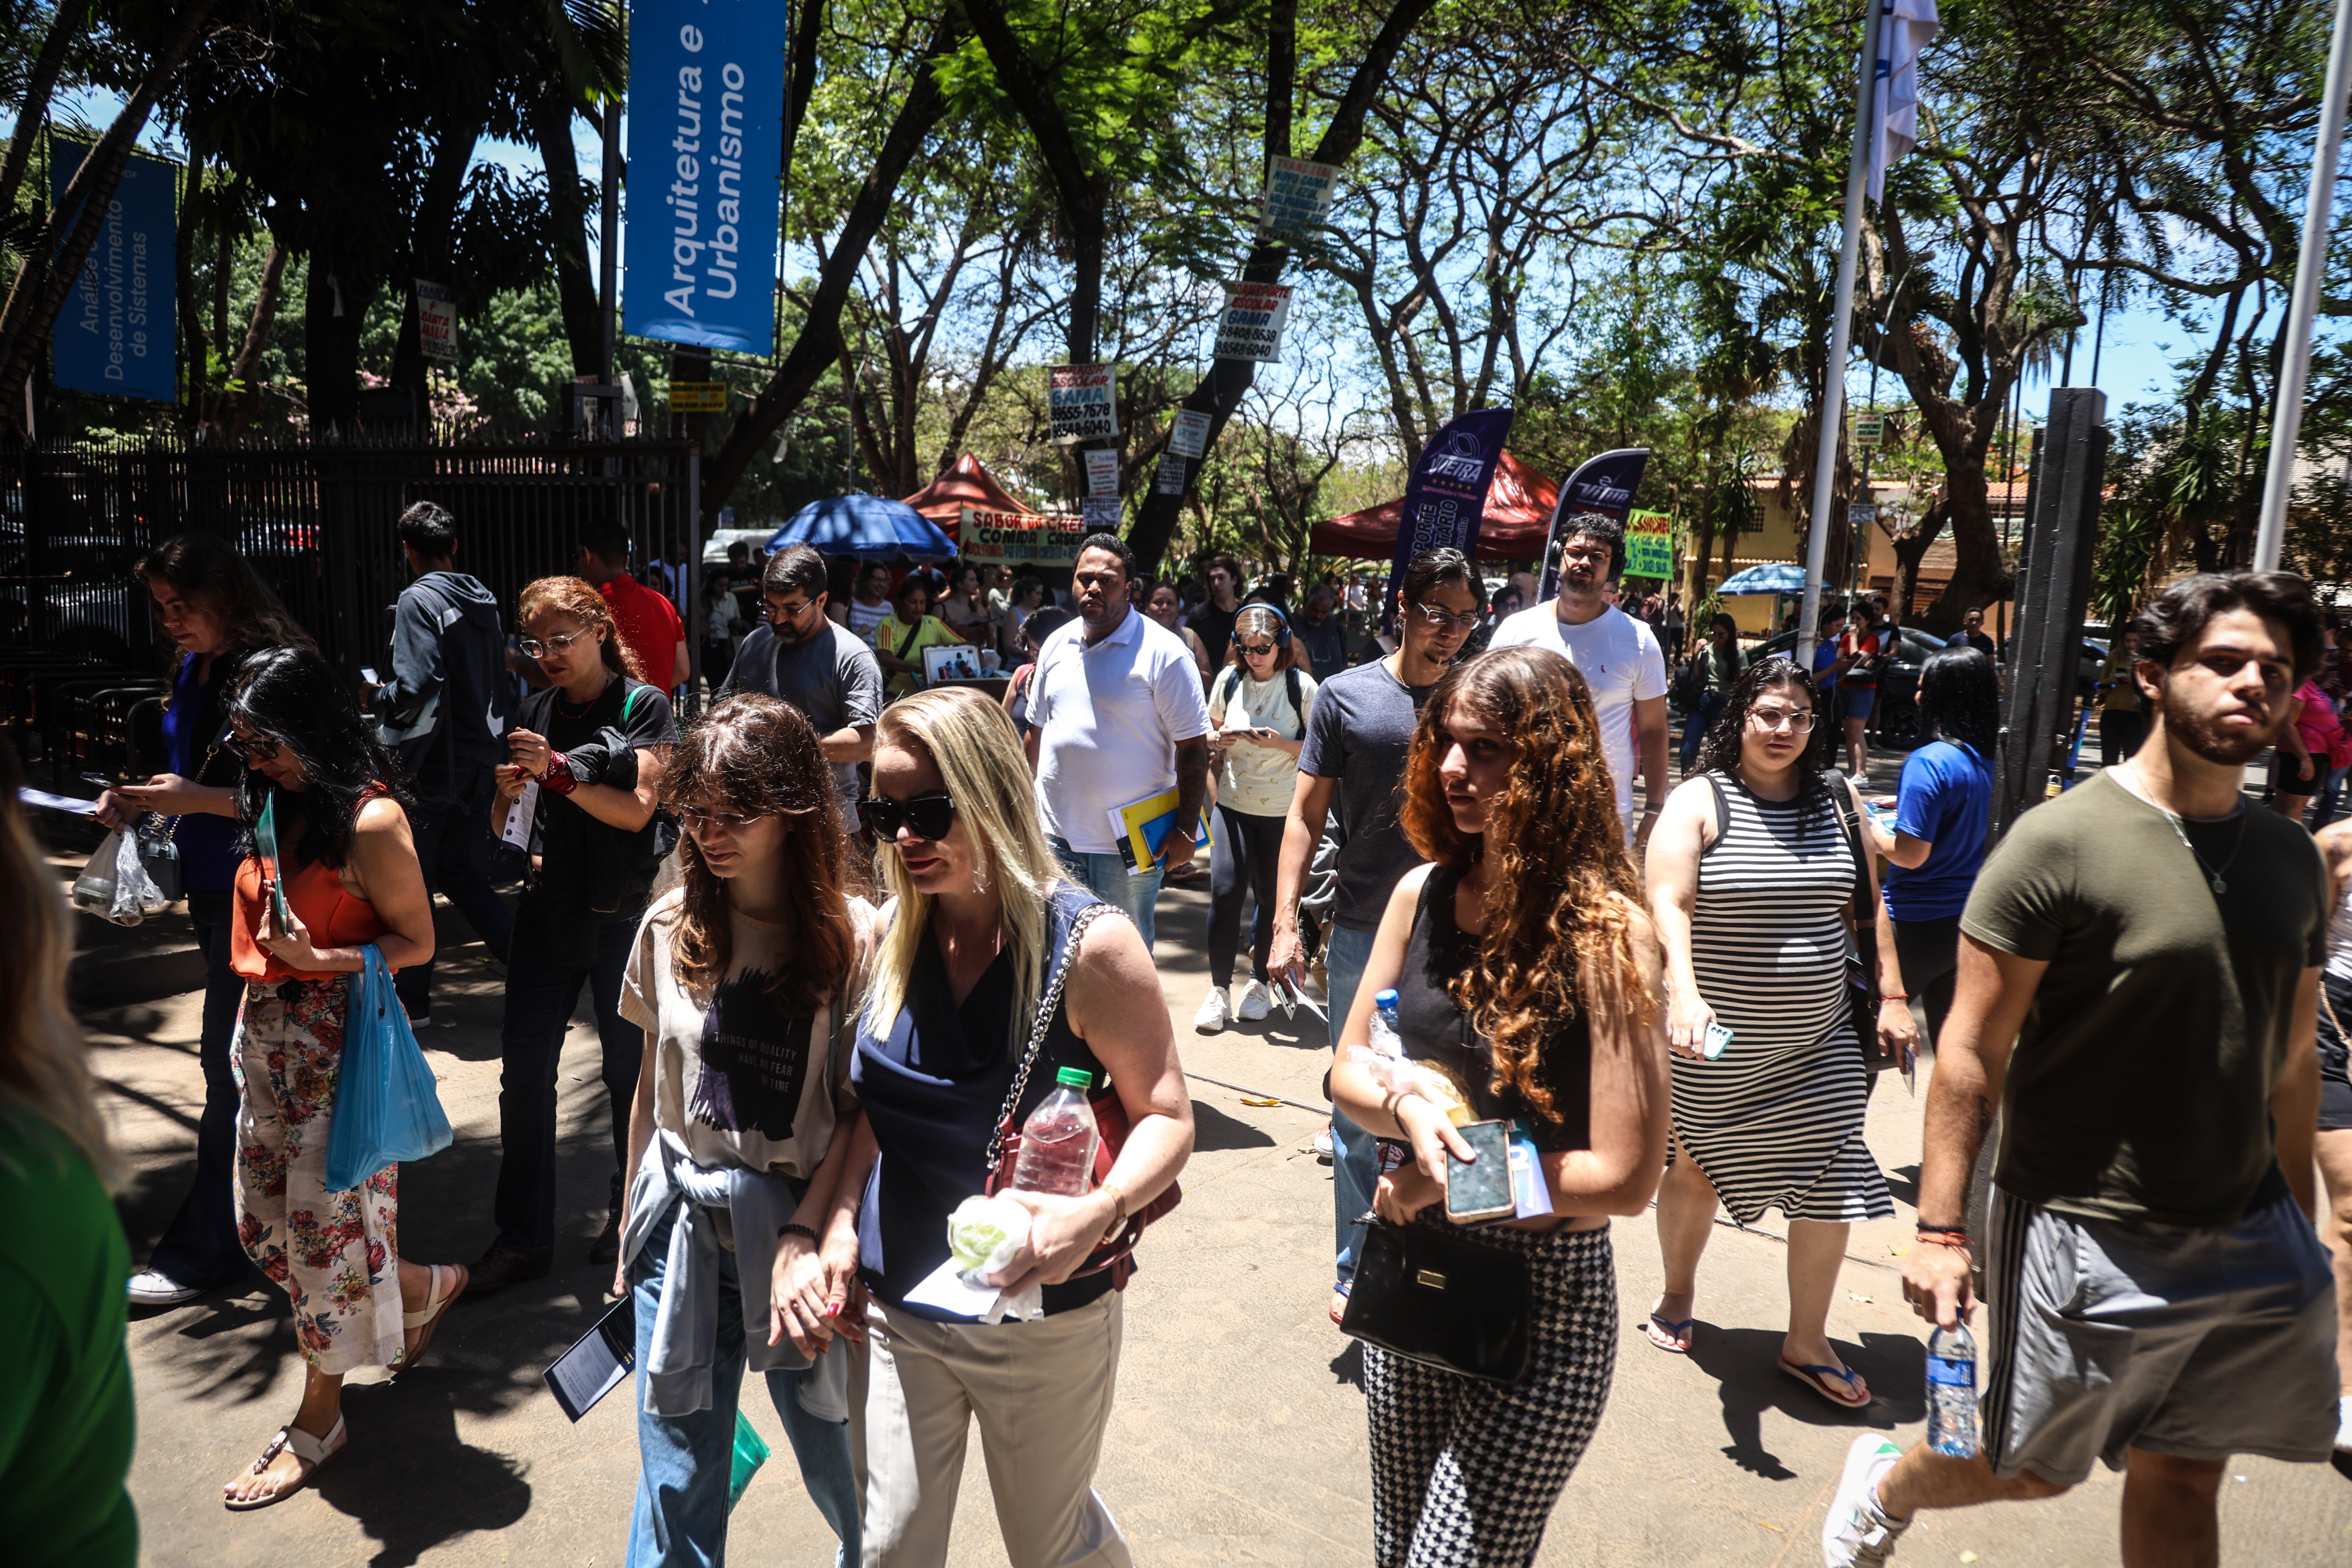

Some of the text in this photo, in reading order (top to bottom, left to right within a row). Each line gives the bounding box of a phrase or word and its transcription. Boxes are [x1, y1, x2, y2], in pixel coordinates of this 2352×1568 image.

[665, 24, 704, 318] Arquitetura e
[707, 63, 745, 299] Urbanismo
[1274, 170, 1329, 190] NOVO GAMA
[1296, 186, 1318, 200] AZUL
[105, 200, 123, 381] Desenvolvimento
[128, 231, 147, 357] de Sistemas
[1232, 296, 1279, 312] ESCOLAR
[1227, 309, 1271, 326] GAMA
[1051, 375, 1109, 388] ESCOLAR
[1053, 387, 1104, 405] GAMA
[973, 511, 1022, 529] SABOR
[1047, 518, 1085, 532] CHEF
[979, 527, 1038, 544] COMIDA
[714, 1031, 797, 1060] THINGS OF QUALITY
[739, 1052, 793, 1076] HAVE NO FEAR
[761, 1074, 790, 1093] OF TIME
